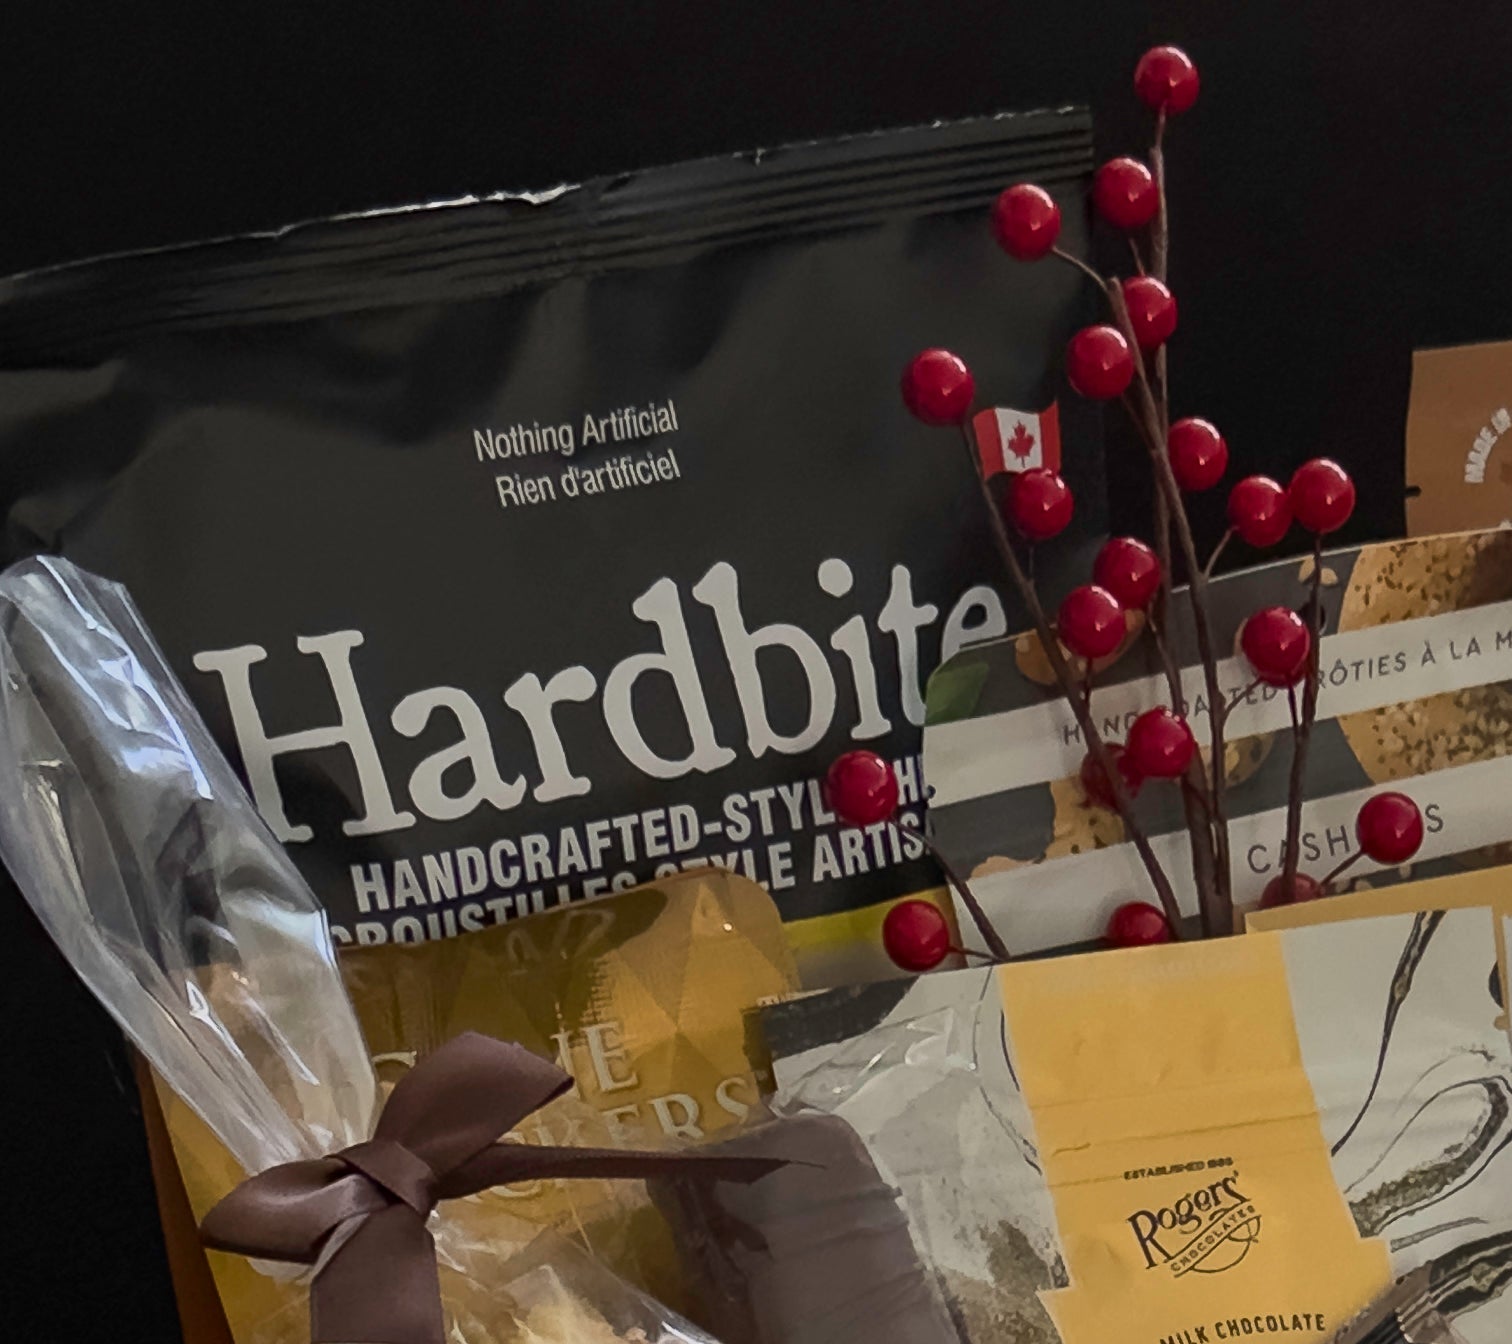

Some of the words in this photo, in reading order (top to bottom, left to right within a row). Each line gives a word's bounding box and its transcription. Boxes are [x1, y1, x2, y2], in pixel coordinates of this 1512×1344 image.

[473, 418, 575, 462] Nothing
[582, 399, 679, 446] Artificial
[495, 473, 556, 507] Rien
[561, 449, 681, 497] d'artificiel
[193, 558, 1007, 843] Hardbite
[1063, 710, 1140, 746] HND
[1421, 640, 1438, 667] À
[1449, 635, 1482, 661] LA
[351, 779, 836, 914] HANDCRAFTED-STYL
[813, 812, 930, 882] ARTIS
[1248, 803, 1444, 874] CSHS
[1124, 1159, 1205, 1180] ESTABLISHED
[1171, 1204, 1256, 1272] CHOCOLATES
[1214, 1314, 1326, 1339] CHOCOLATE
